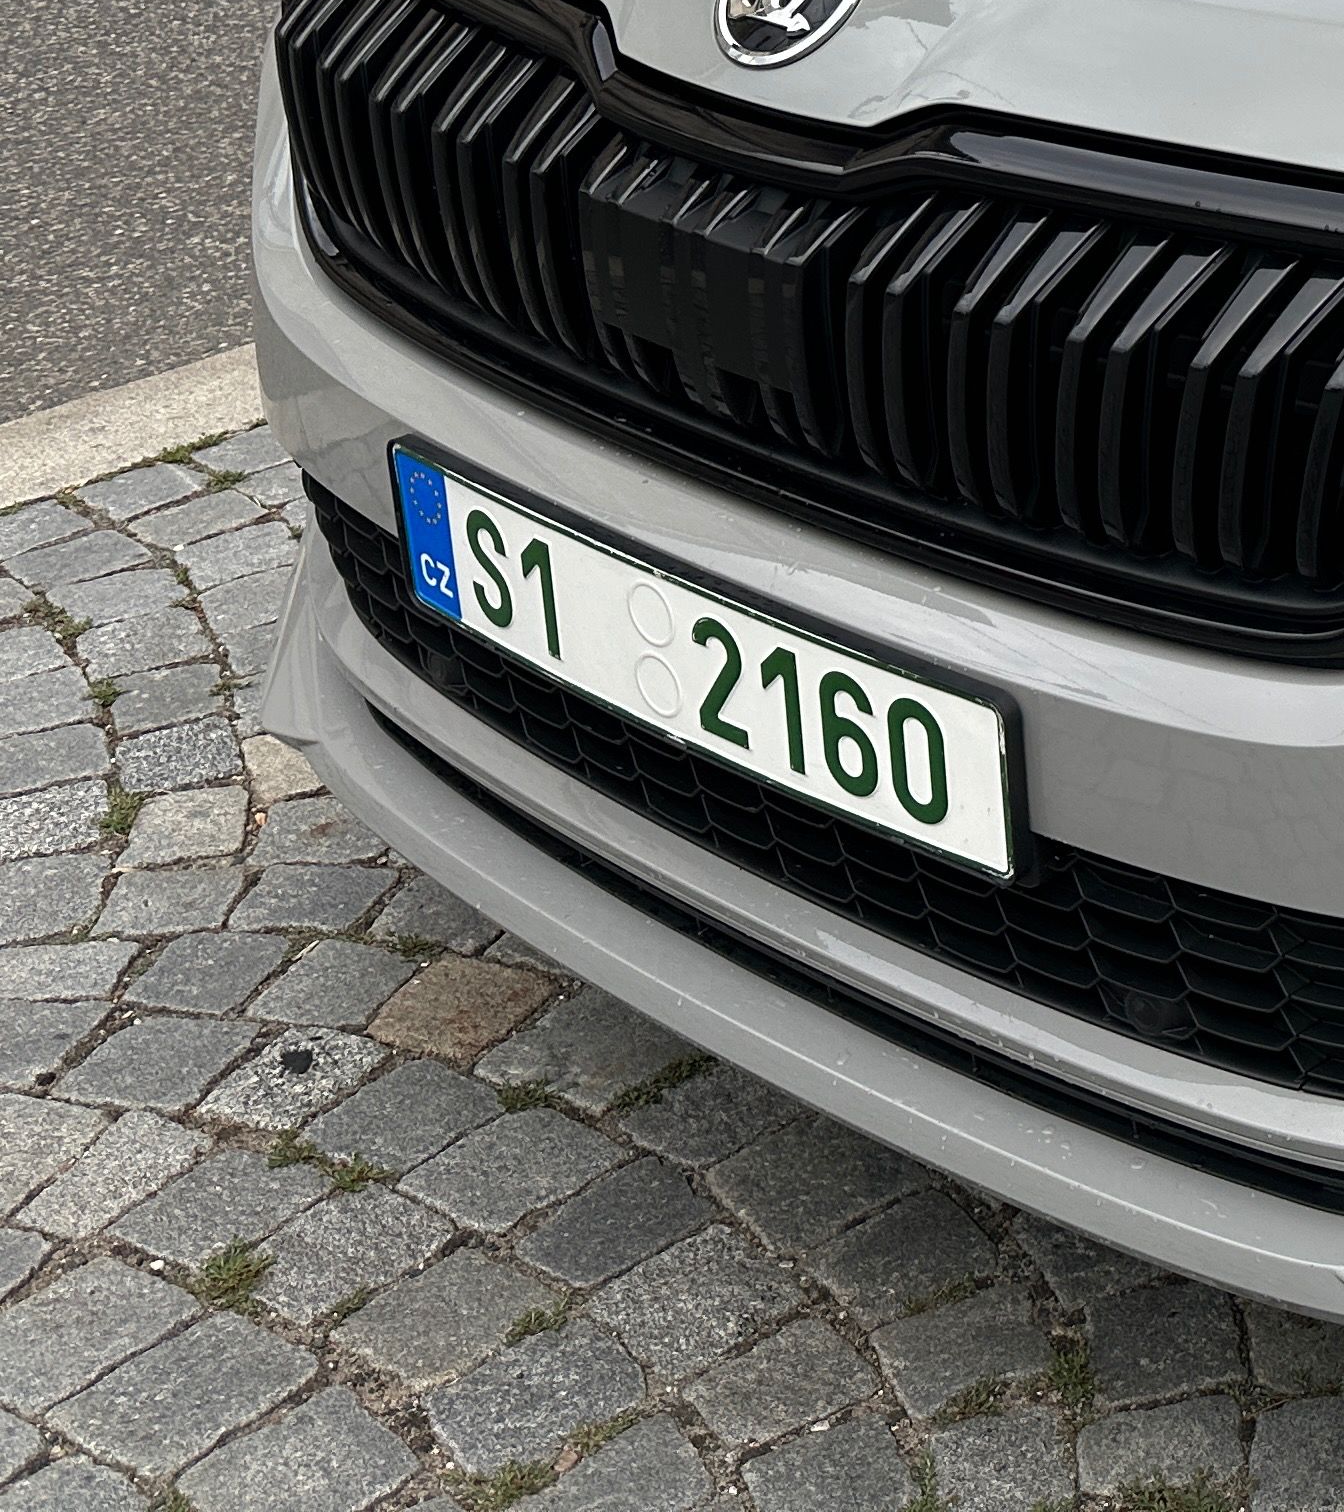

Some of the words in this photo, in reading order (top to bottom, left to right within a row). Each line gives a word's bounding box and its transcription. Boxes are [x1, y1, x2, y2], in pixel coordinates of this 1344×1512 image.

[419, 551, 455, 600] CZ
[464, 508, 563, 661] S1
[691, 616, 950, 826] 2160
